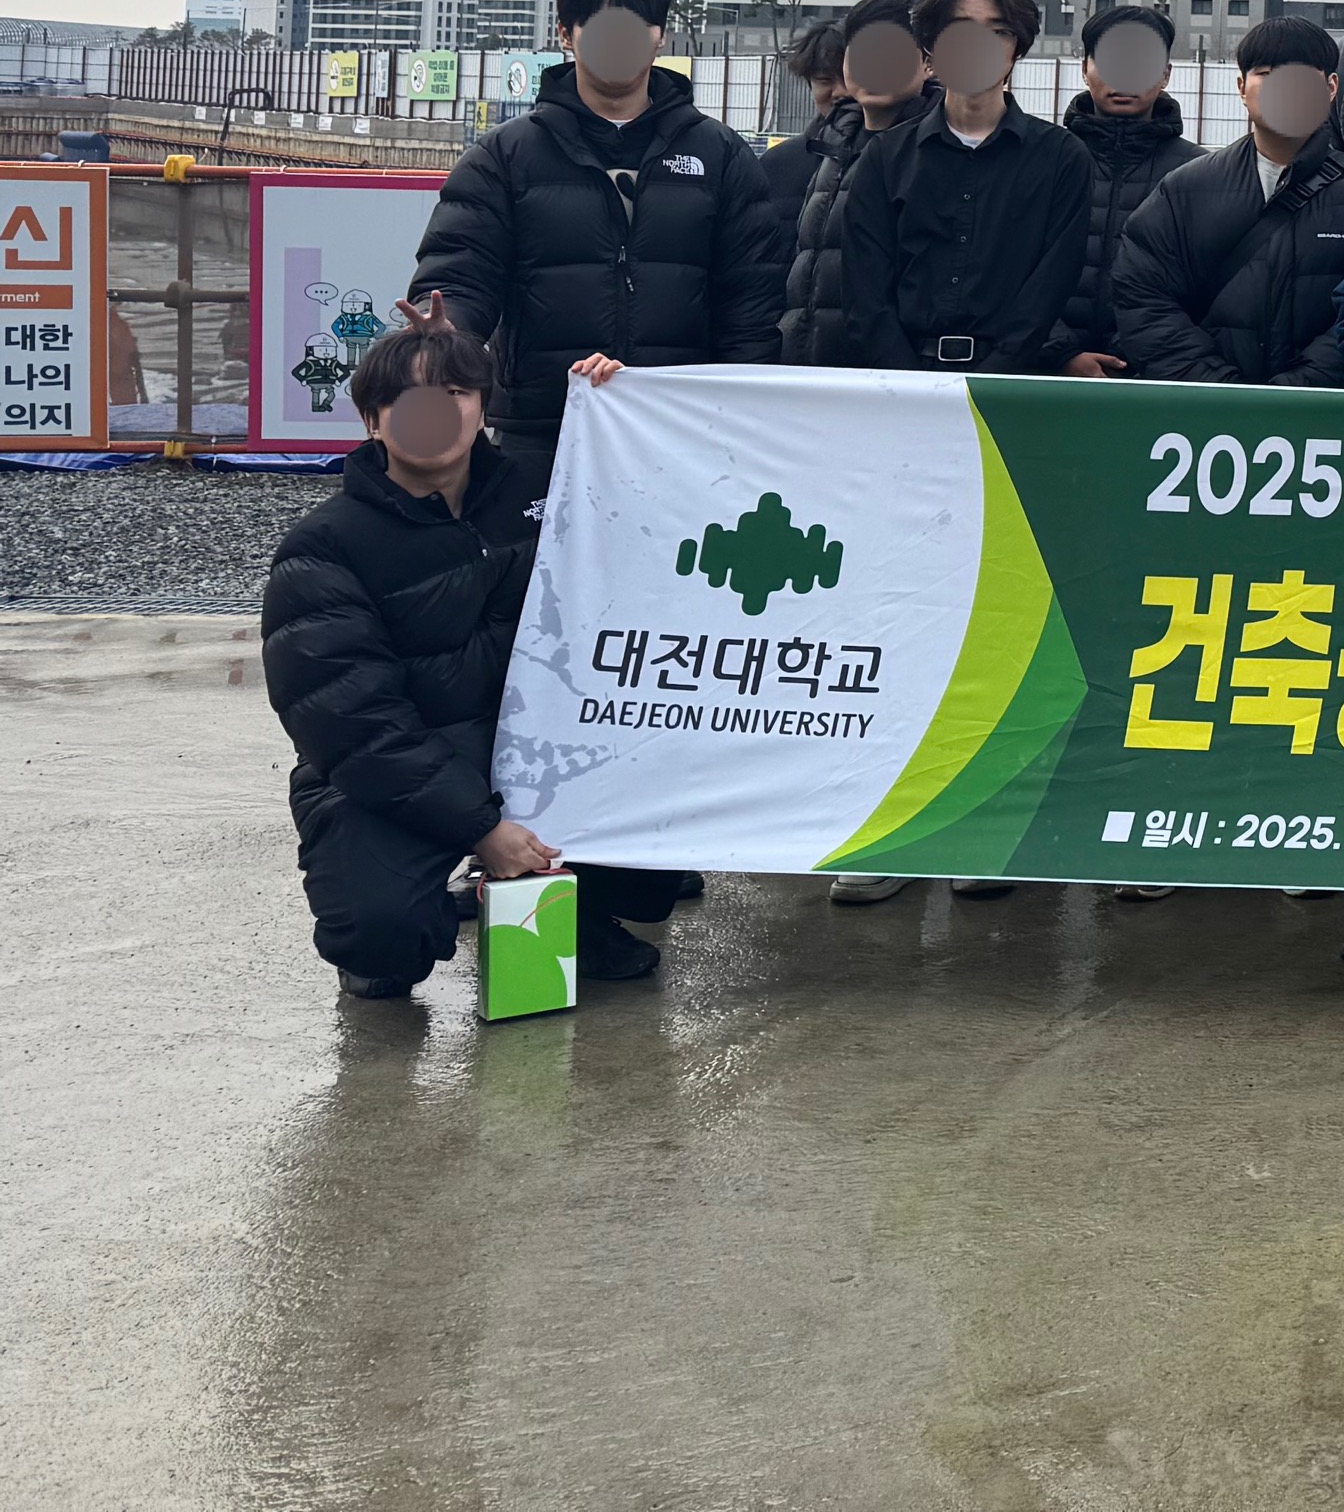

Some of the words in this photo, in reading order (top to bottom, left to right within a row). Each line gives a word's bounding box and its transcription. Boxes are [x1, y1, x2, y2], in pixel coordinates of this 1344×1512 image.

[663, 160, 690, 168] NORTH
[1, 205, 73, 271] 신
[4, 323, 73, 352] 대한
[4, 363, 71, 391] 나의
[592, 629, 882, 699] 대전대학교
[578, 698, 704, 731] DAEJEON
[710, 706, 875, 739] UNIVERSITY
[1233, 814, 1341, 851] 2025.
